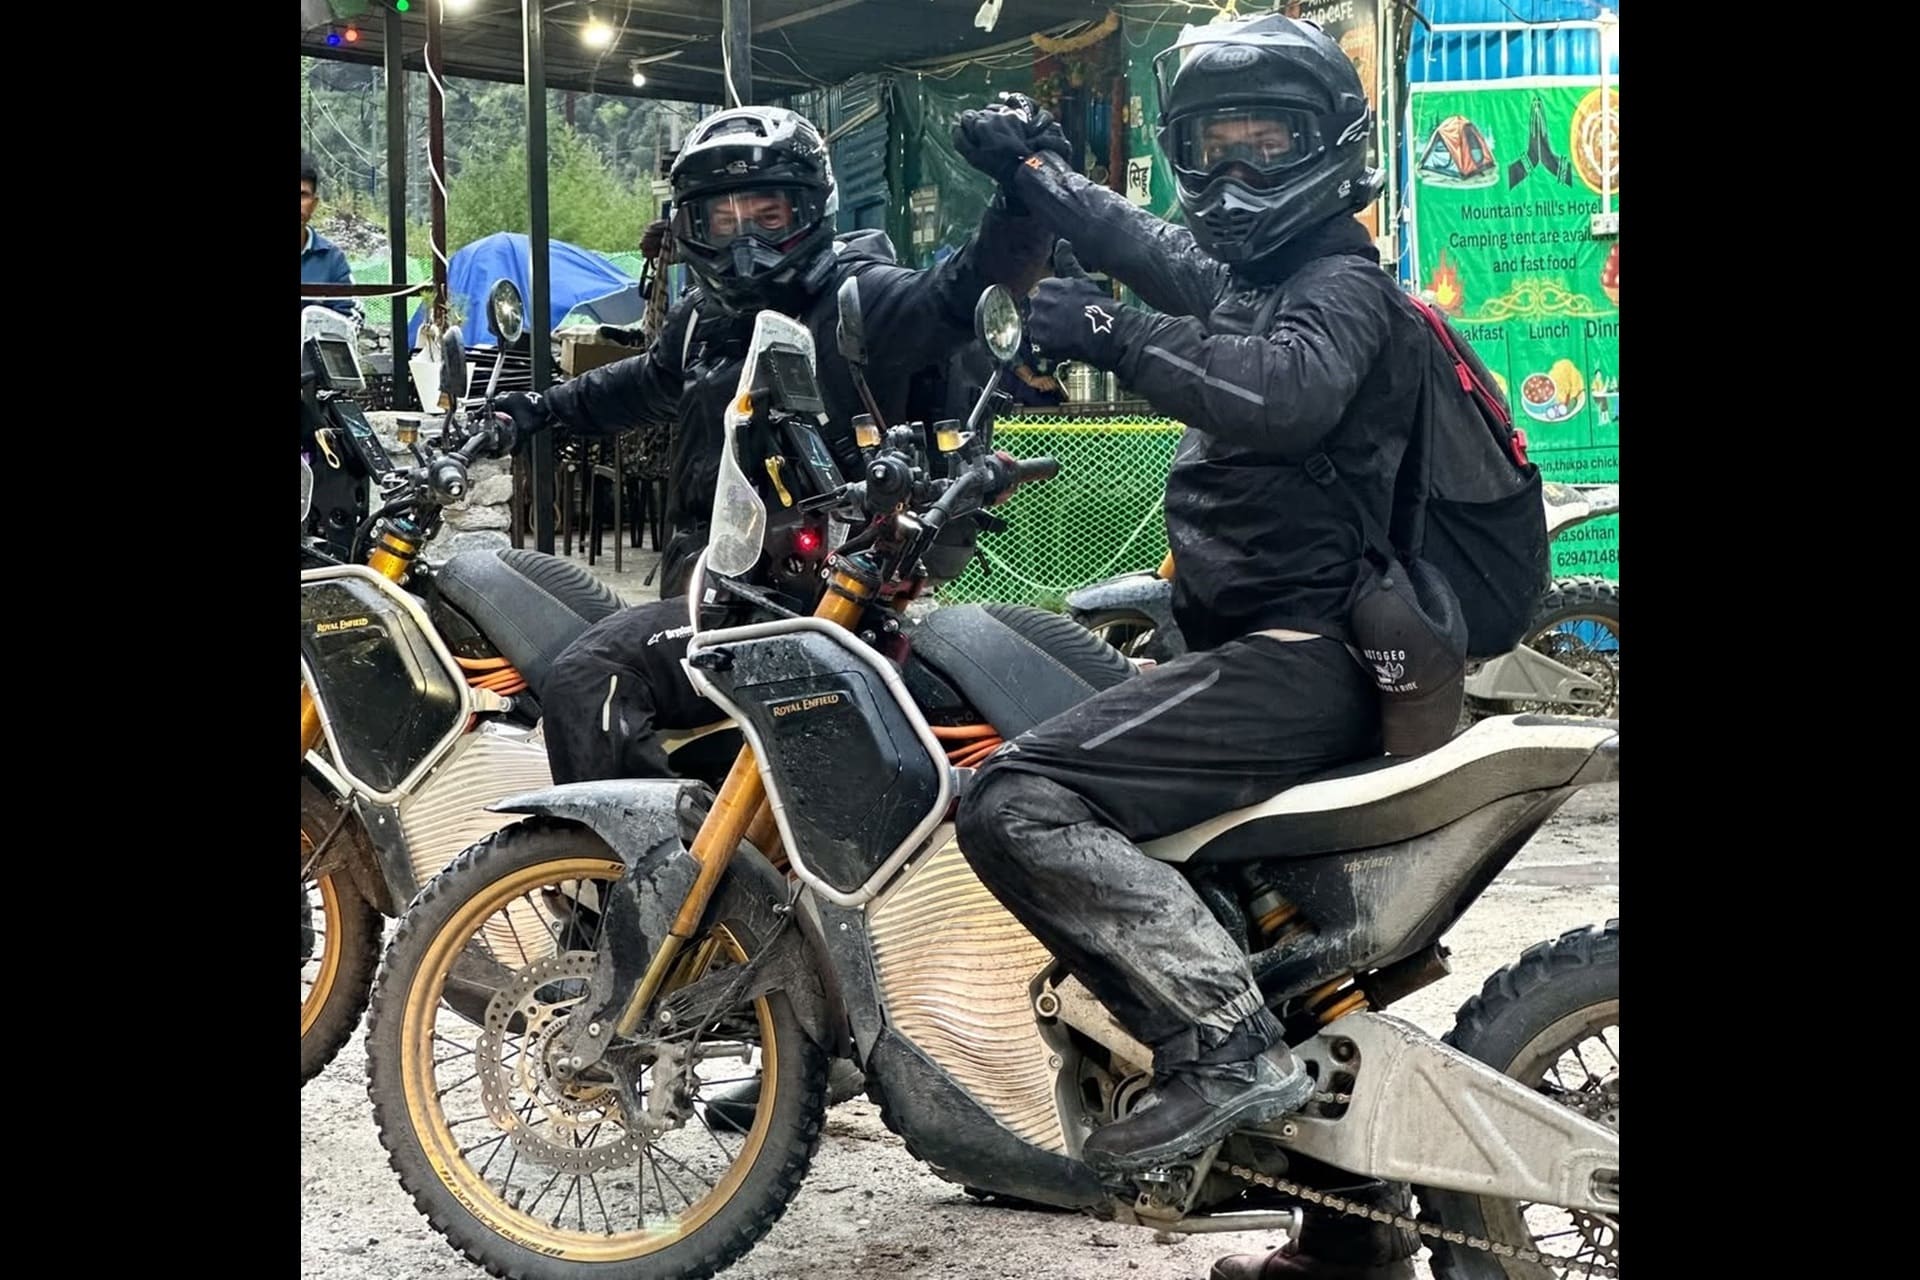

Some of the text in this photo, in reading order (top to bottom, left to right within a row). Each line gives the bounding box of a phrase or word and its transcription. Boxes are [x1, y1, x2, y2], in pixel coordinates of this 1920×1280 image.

[1461, 203, 1532, 220] Mountain's
[1535, 201, 1565, 217] hill's
[1450, 231, 1508, 249] Camping
[1511, 231, 1536, 245] tent
[1539, 232, 1560, 244] are
[1493, 253, 1577, 273] and fast food
[1460, 325, 1505, 341] akfast
[1529, 321, 1570, 340] Lunch
[1557, 548, 1619, 567] 62947148
[316, 618, 368, 632] ROYAL ENFIELD
[773, 694, 839, 717] ROYAL ENFIELD
